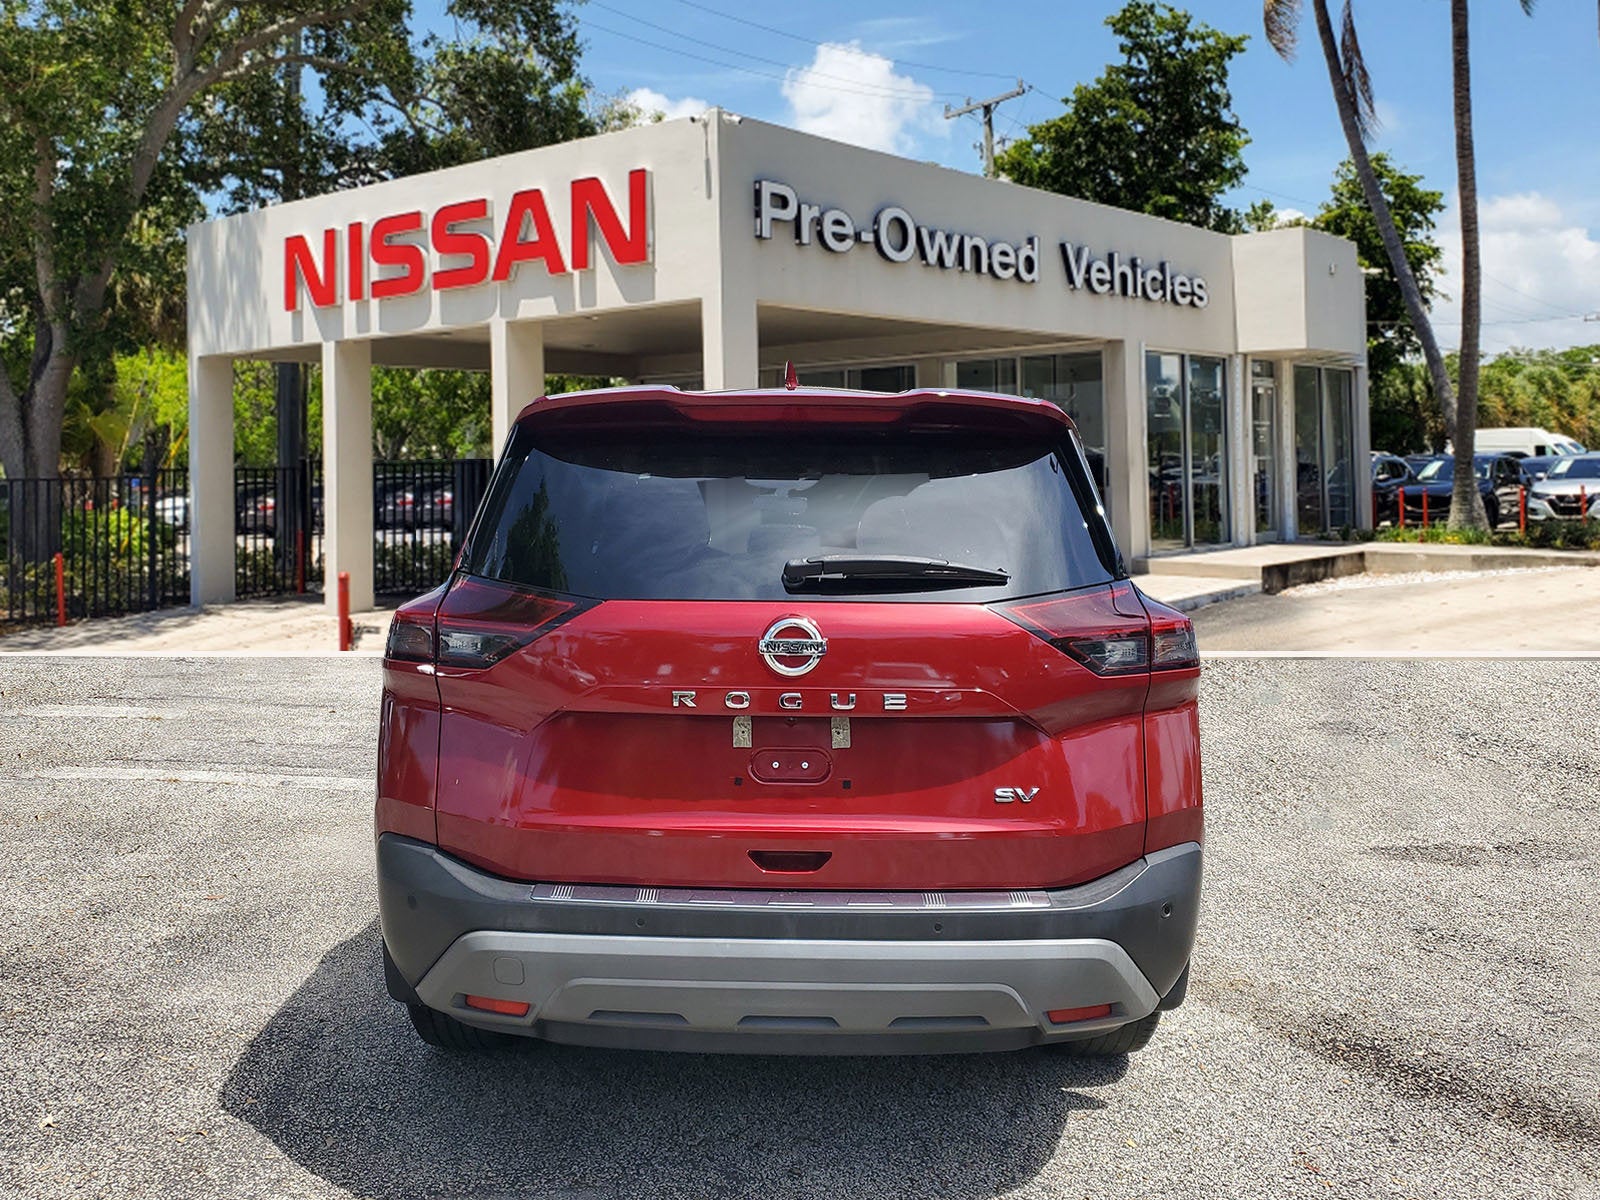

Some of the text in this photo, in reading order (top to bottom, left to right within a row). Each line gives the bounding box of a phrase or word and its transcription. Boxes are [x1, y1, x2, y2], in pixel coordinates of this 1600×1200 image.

[284, 169, 647, 311] NISSAN
[754, 179, 1209, 308] Pre-Owned Vehicles
[765, 641, 821, 653] NISSAN
[672, 691, 908, 710] ROGUE
[994, 787, 1040, 803] SV
